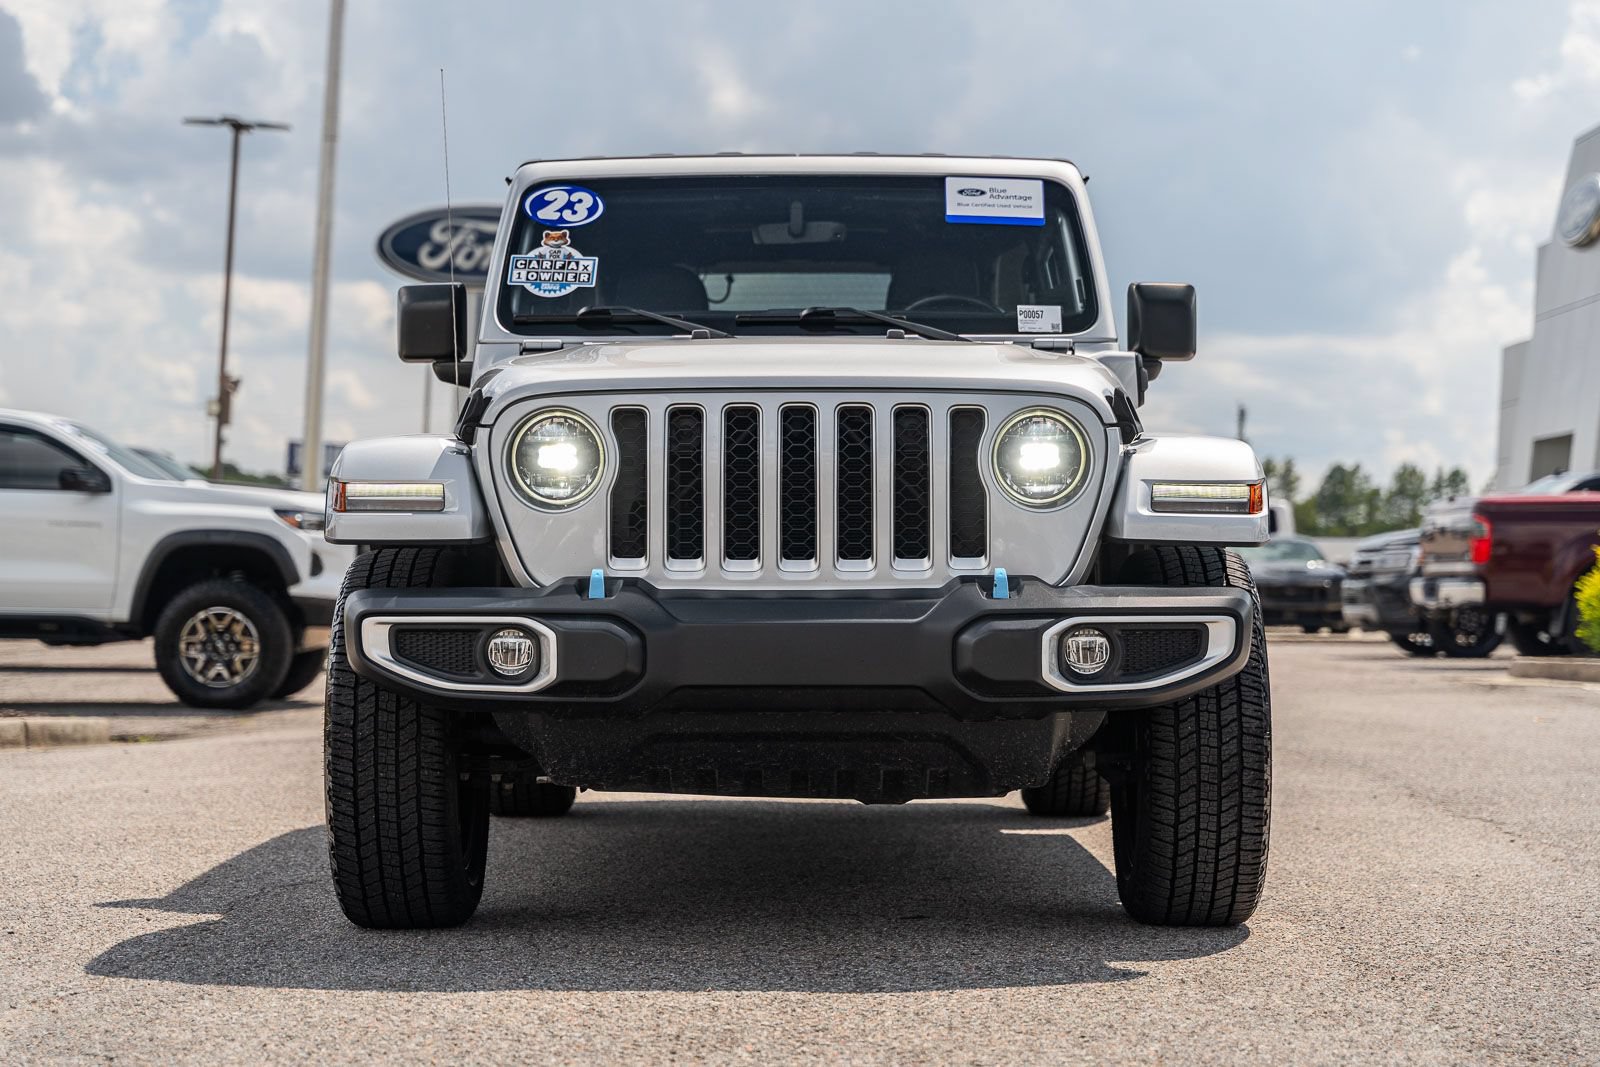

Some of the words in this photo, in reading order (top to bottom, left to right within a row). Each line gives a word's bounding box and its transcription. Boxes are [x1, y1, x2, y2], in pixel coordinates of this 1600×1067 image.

[537, 190, 594, 222] 23
[417, 220, 498, 271] For
[516, 260, 590, 271] CARFAX
[515, 271, 523, 280] 1
[527, 271, 590, 282] OWNER
[1019, 309, 1044, 319] P00057
